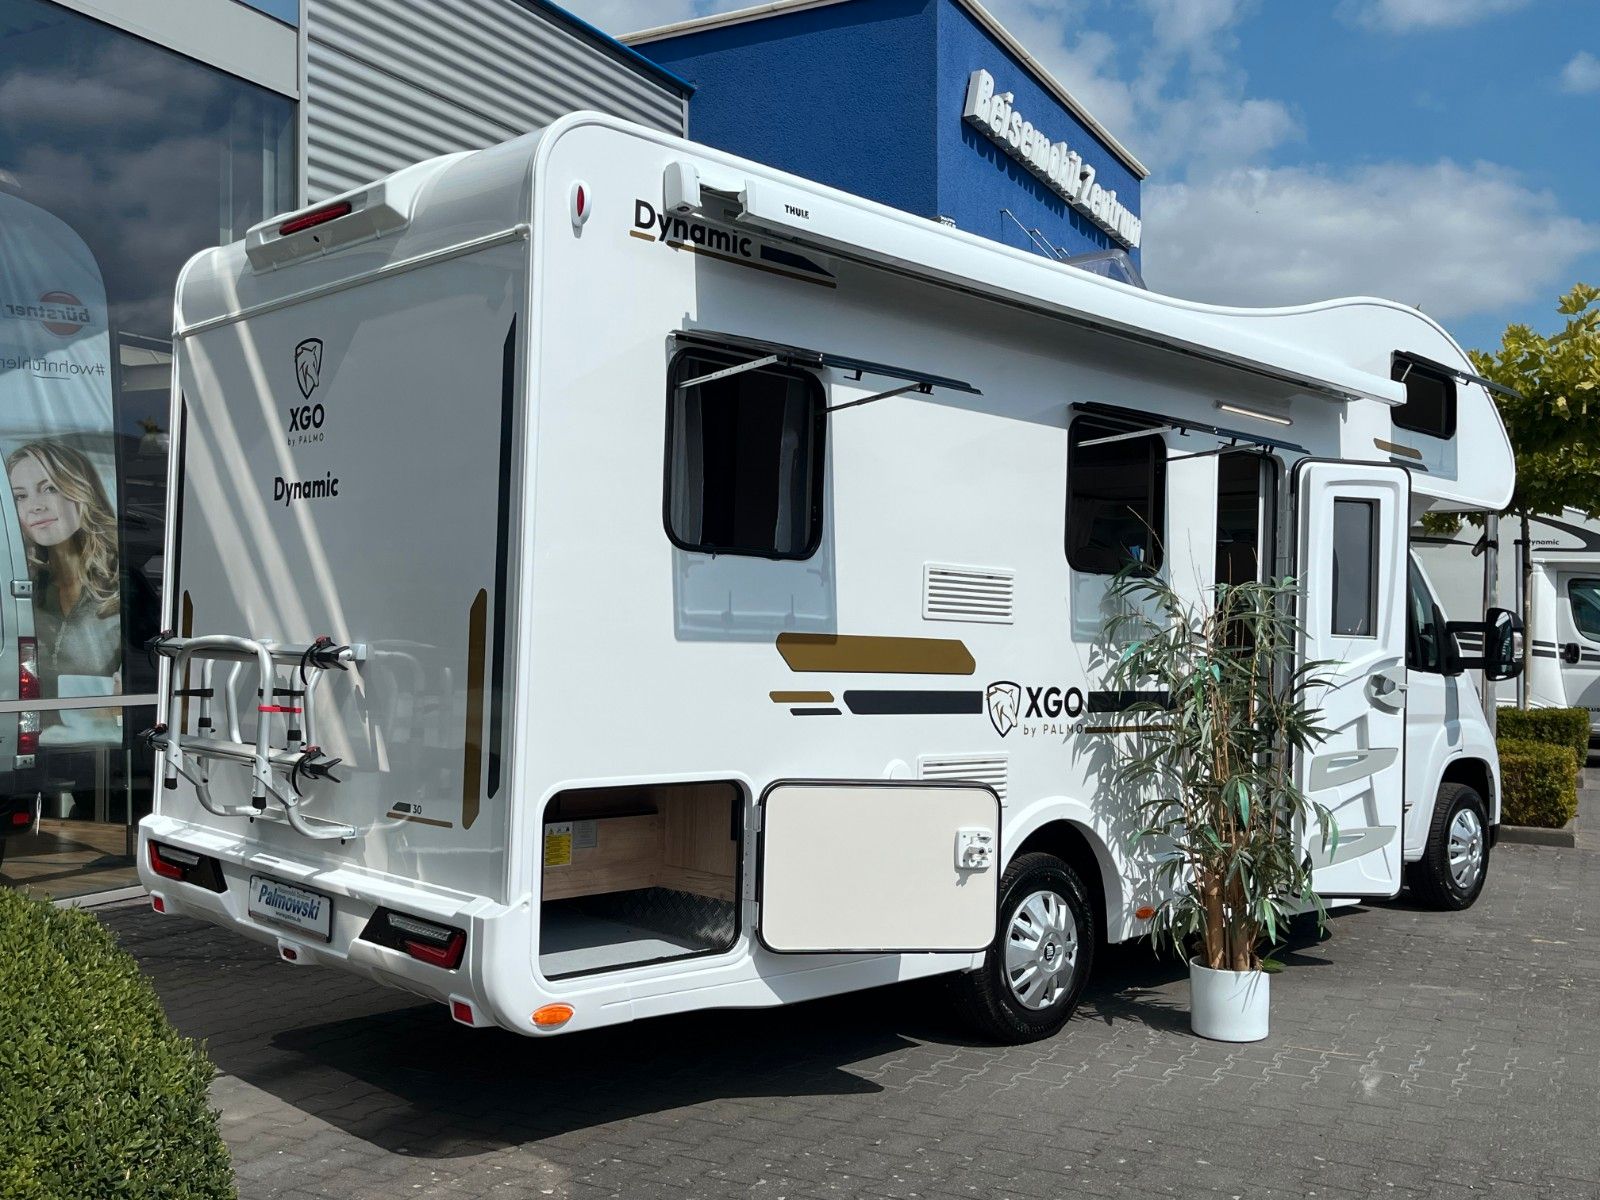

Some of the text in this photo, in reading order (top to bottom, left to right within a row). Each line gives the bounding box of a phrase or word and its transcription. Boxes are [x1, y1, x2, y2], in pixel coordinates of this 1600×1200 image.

[964, 68, 1142, 249] Reisemobil-Zentrum
[784, 204, 810, 219] THULE
[634, 198, 753, 258] Dynamic
[289, 403, 325, 432] XGO
[287, 432, 324, 446] by PALMO
[274, 471, 339, 506] Dynamic
[1024, 686, 1084, 718] XGO
[1023, 723, 1083, 737] by PALMO
[412, 804, 422, 815] 30
[258, 884, 321, 921] Palmowski
